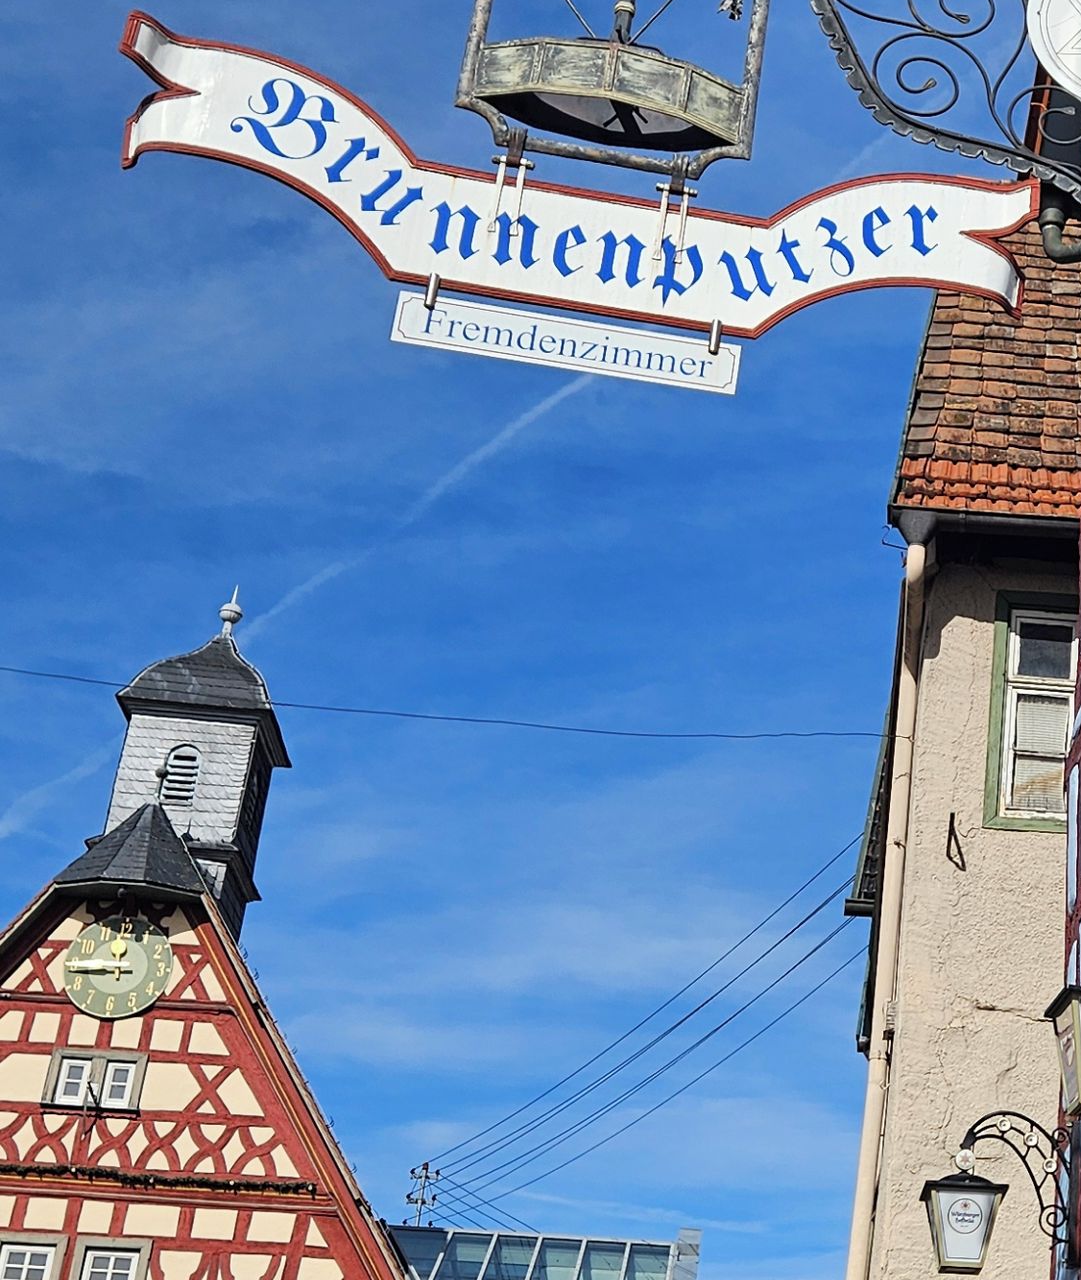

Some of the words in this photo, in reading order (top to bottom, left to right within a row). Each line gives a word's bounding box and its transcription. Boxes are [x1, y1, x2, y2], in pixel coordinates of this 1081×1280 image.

[230, 77, 939, 306] Brunnenputzer
[423, 309, 713, 378] Fremdenzimmer
[100, 926, 111, 941] 11
[120, 923, 133, 938] 12
[143, 930, 149, 944] 1
[81, 939, 95, 954] 10
[153, 944, 163, 959] 2
[156, 962, 165, 977] 3
[73, 976, 82, 991] 8
[145, 981, 155, 996] 4
[86, 989, 95, 1005] 7
[106, 996, 115, 1011] 6
[128, 992, 137, 1007] 5
